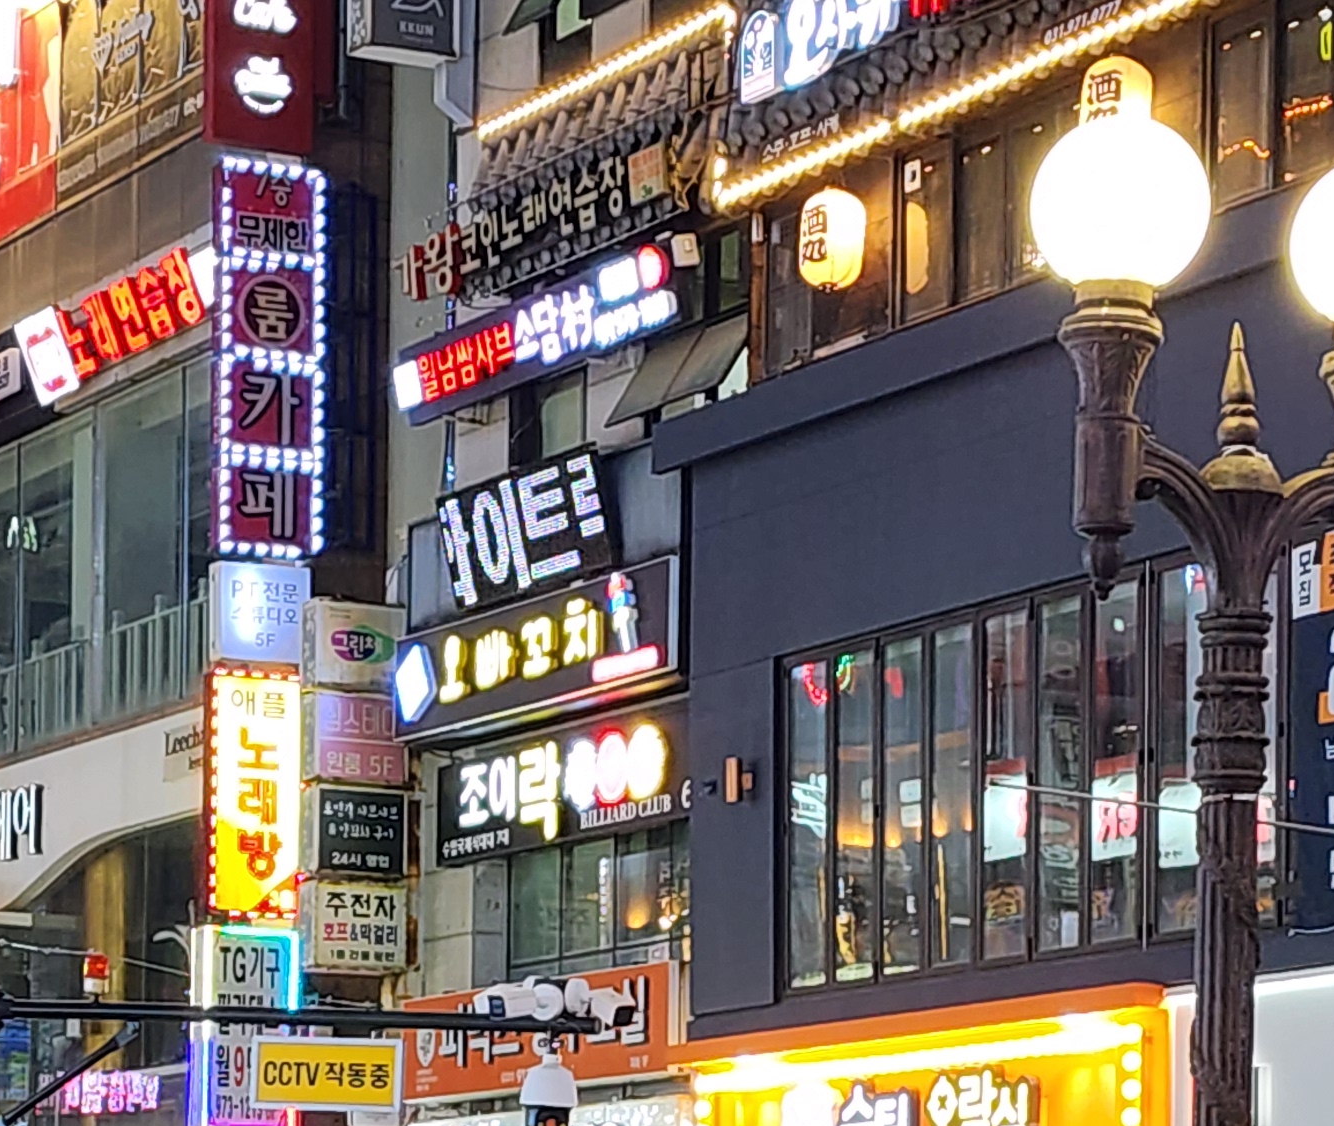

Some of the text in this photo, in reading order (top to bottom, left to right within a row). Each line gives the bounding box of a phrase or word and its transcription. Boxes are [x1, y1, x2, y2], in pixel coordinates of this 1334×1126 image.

[398, 20, 435, 37] KKUN
[237, 213, 310, 250] 무제한
[255, 633, 276, 648] 5F
[231, 688, 287, 718] 애플
[370, 757, 395, 777] 5F
[236, 726, 281, 881] 노래방
[580, 794, 672, 830] BILLIARD CLUB
[331, 852, 361, 867] 24시
[325, 892, 397, 921] 주전자
[218, 945, 280, 990] TG기구
[263, 1060, 391, 1089] CCTV 작동중
